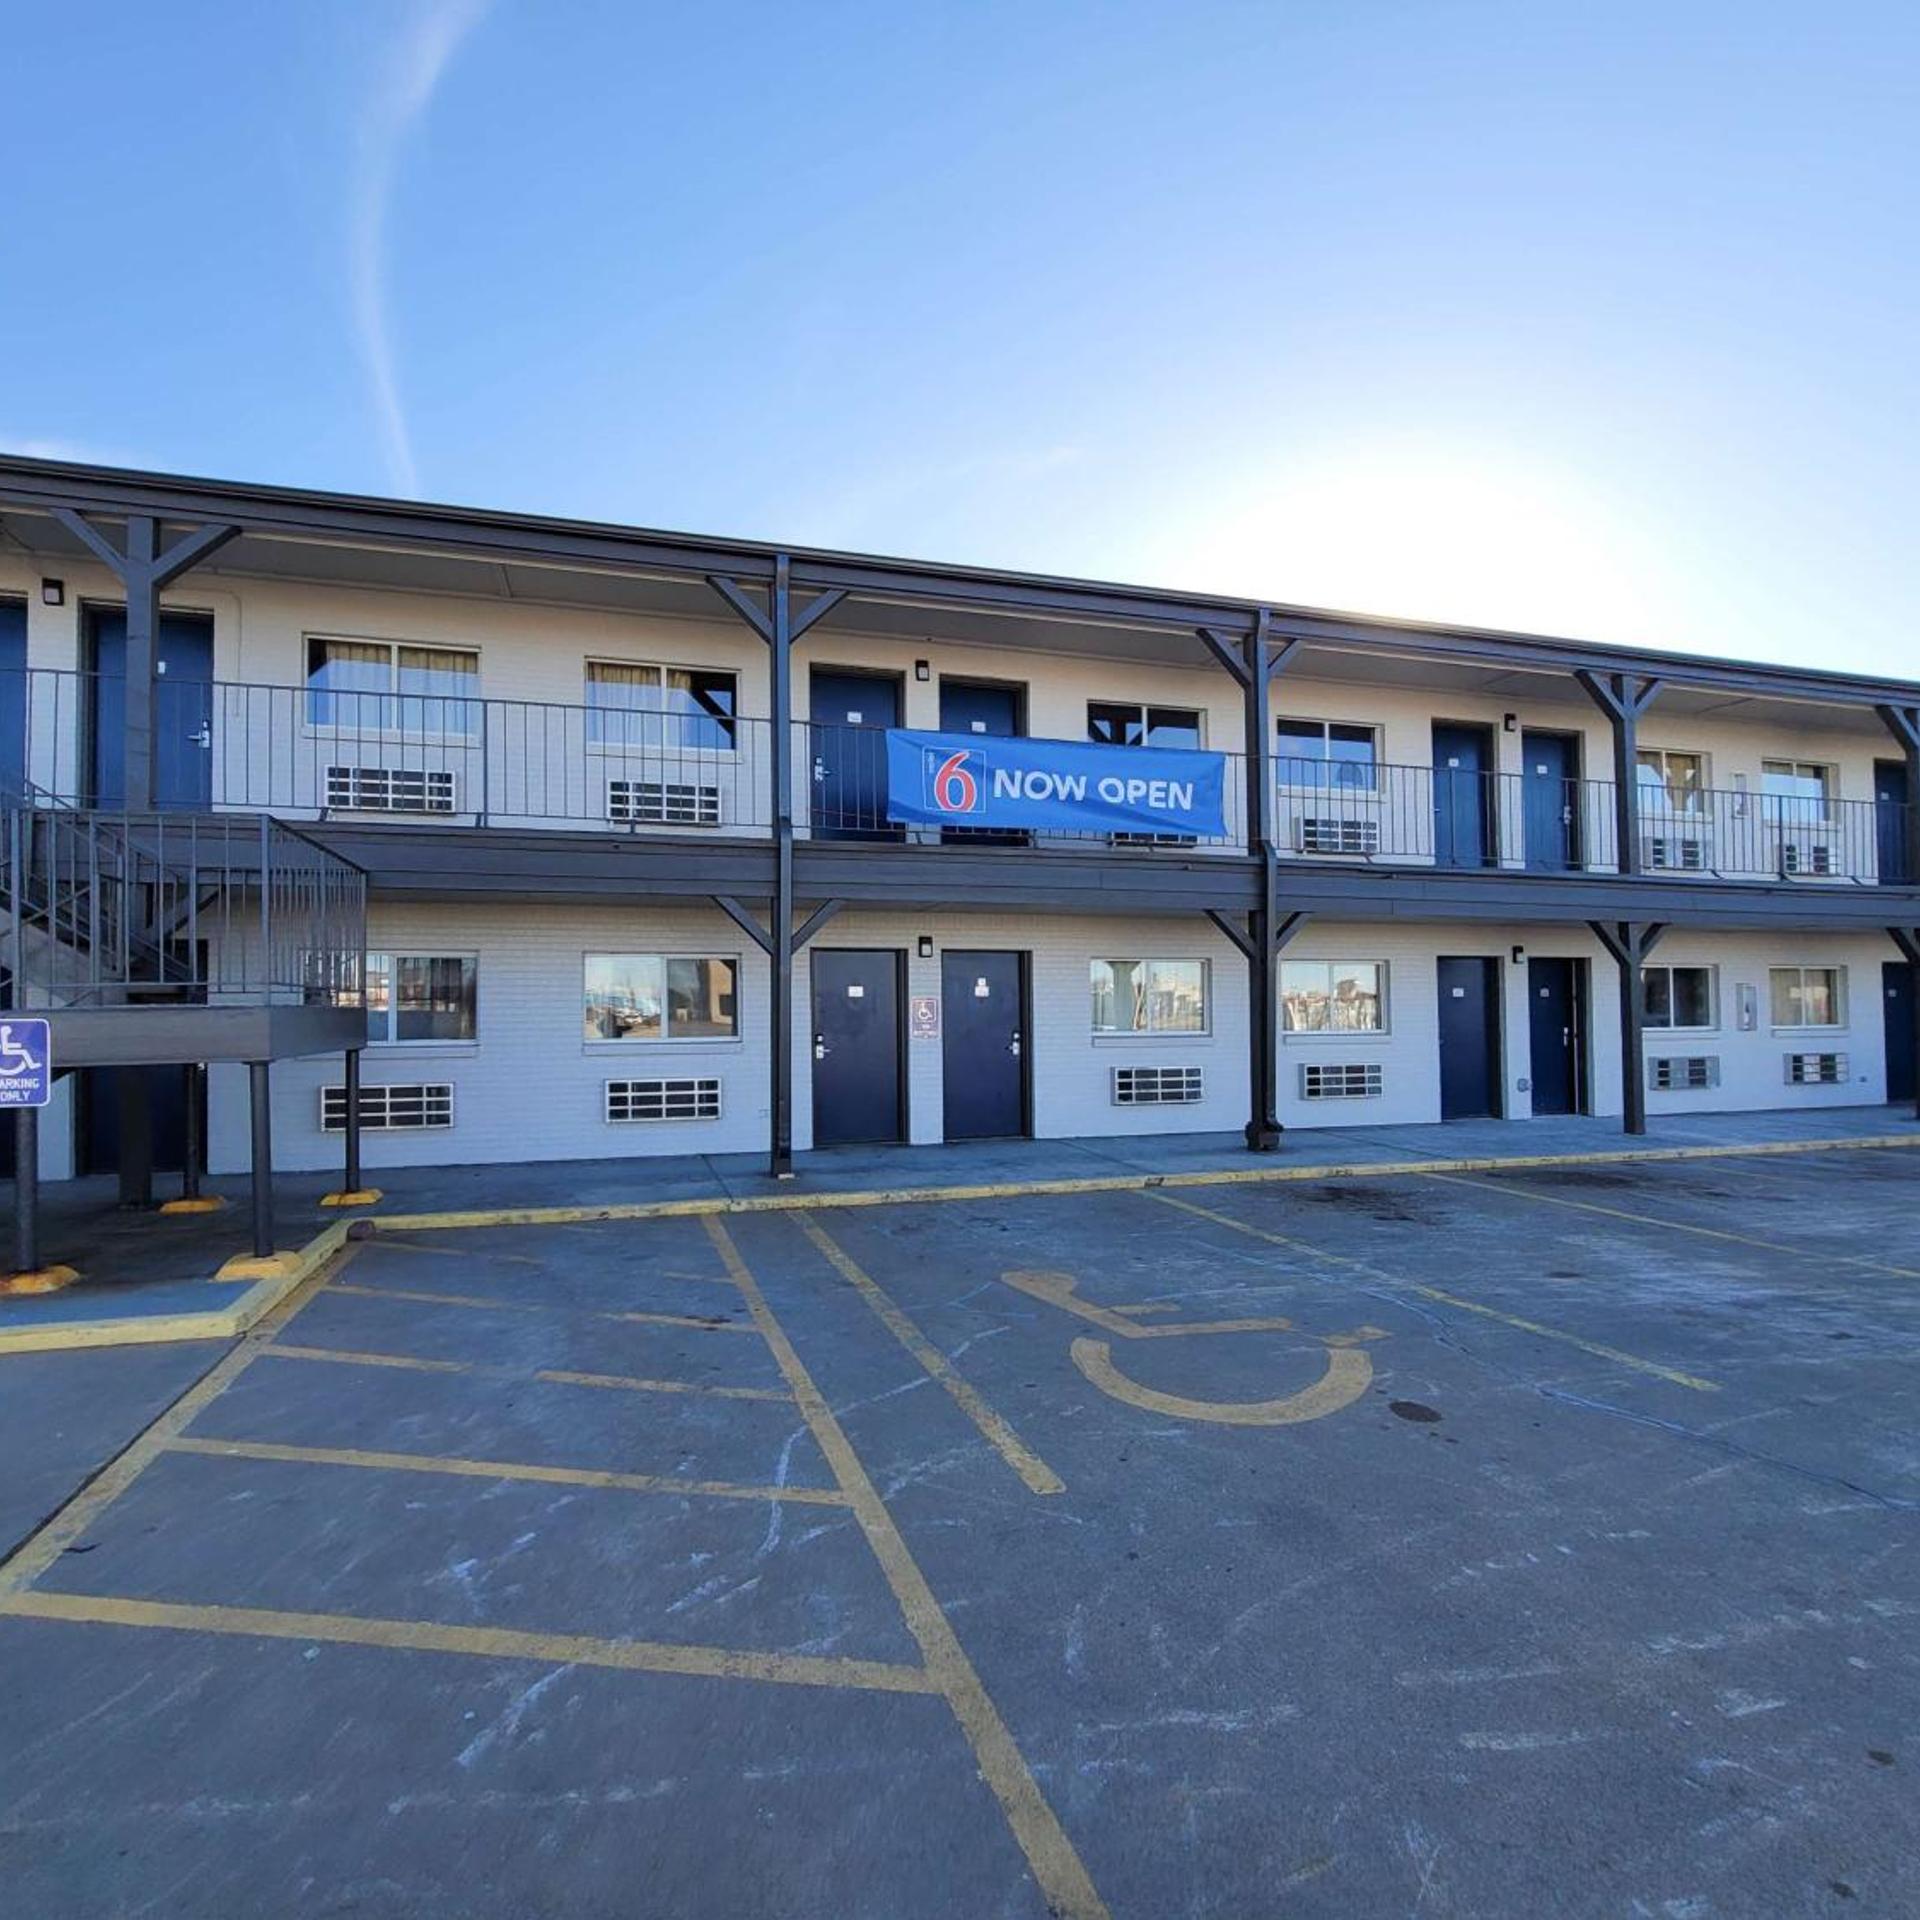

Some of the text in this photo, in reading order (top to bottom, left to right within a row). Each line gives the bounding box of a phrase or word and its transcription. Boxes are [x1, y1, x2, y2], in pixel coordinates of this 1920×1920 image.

[933, 750, 978, 812] 6
[993, 768, 1193, 811] NOW OPEN
[0, 1078, 40, 1090] ARKING
[0, 1090, 31, 1101] ONLY
